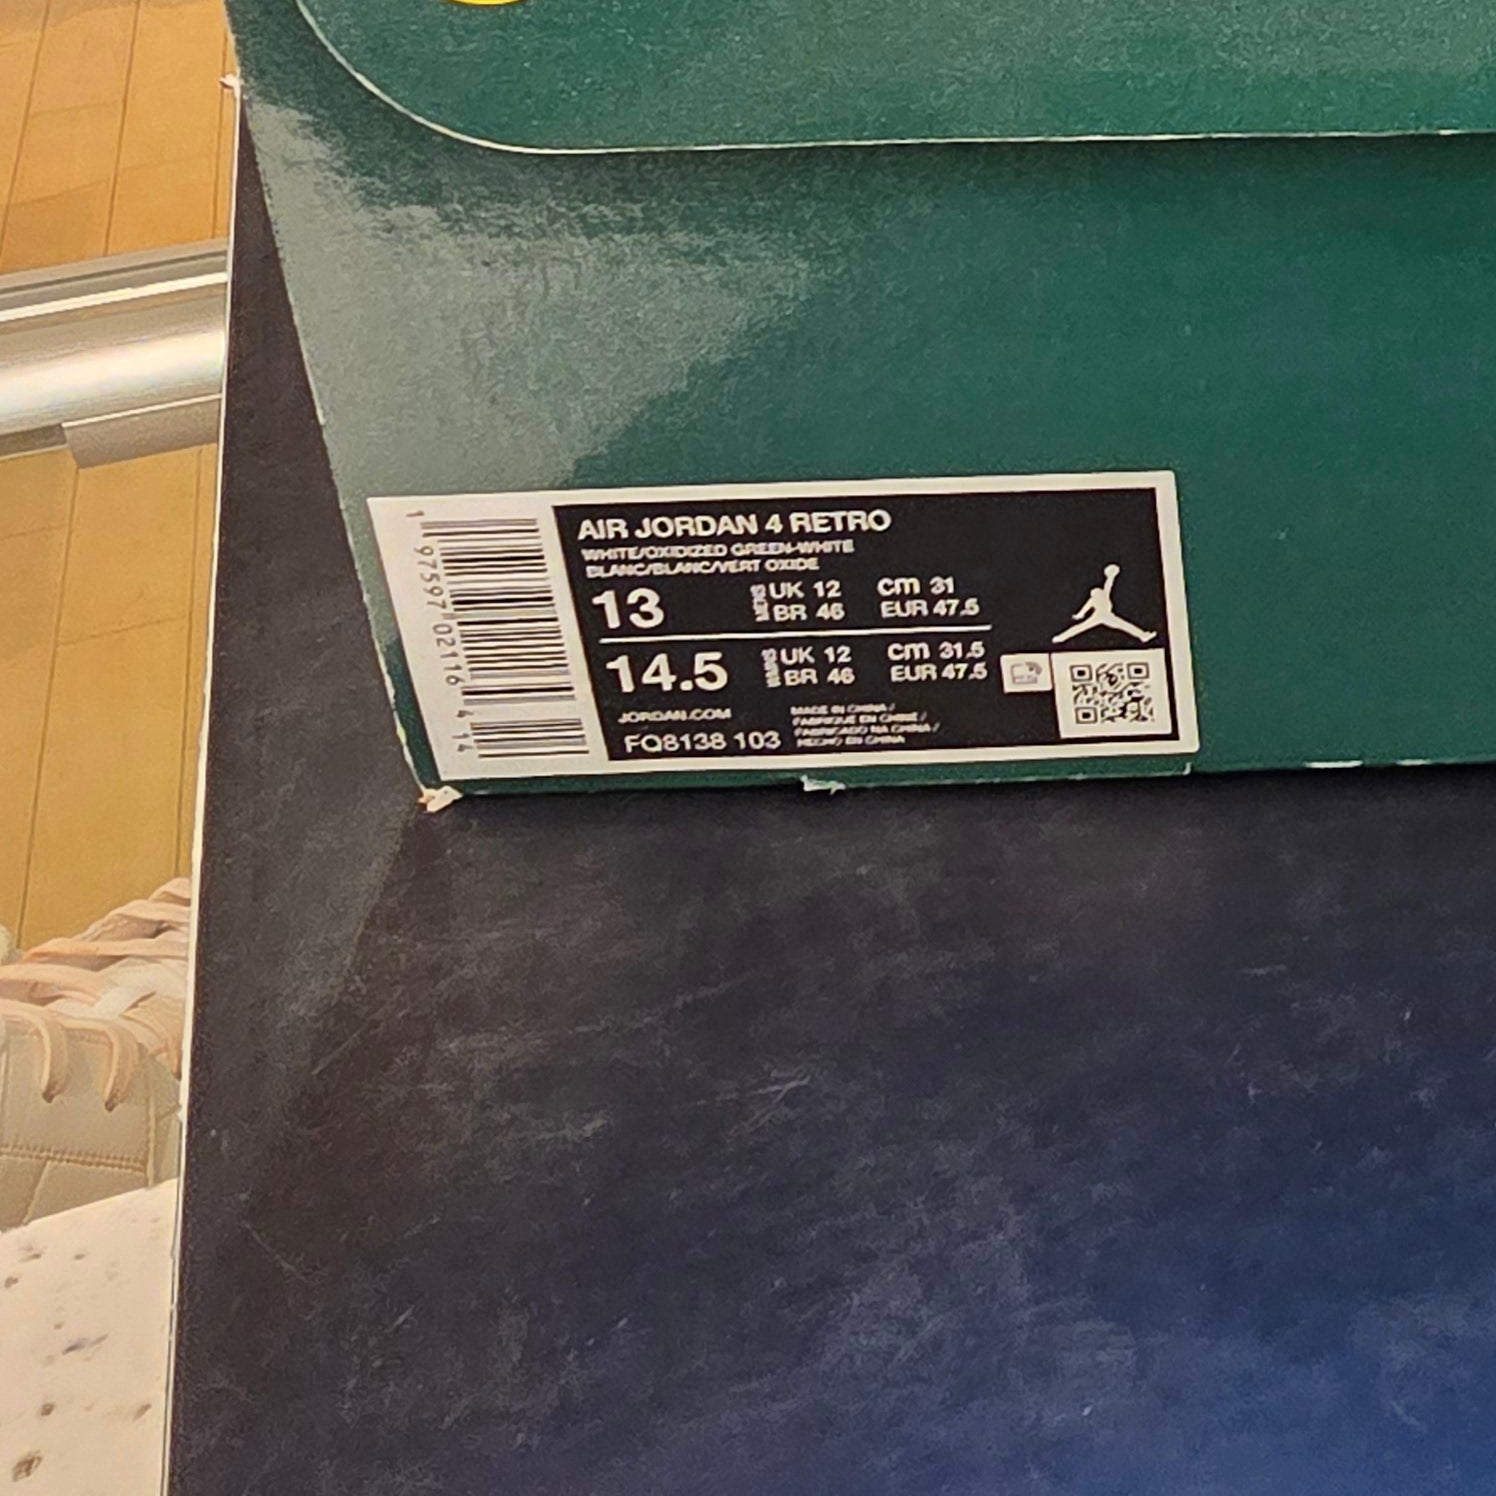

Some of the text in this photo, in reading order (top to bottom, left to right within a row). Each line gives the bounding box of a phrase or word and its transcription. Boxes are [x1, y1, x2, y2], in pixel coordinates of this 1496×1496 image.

[577, 508, 892, 541] AIR JORDAN 4 RETRO
[730, 539, 855, 557] GREEN-WHITE
[769, 579, 843, 600] UK 12
[929, 576, 955, 595] 31
[592, 587, 665, 630] 13
[772, 602, 846, 622] BR 46
[880, 597, 980, 619] EUR 47.5
[780, 645, 852, 665] UK 12
[938, 640, 986, 660] 31.5
[606, 651, 729, 693] 14.5
[783, 666, 855, 687] BR 46
[890, 661, 988, 683] EUR 47.5
[617, 707, 732, 724] JORDAN.COM
[623, 730, 782, 753] FQ8138 103
